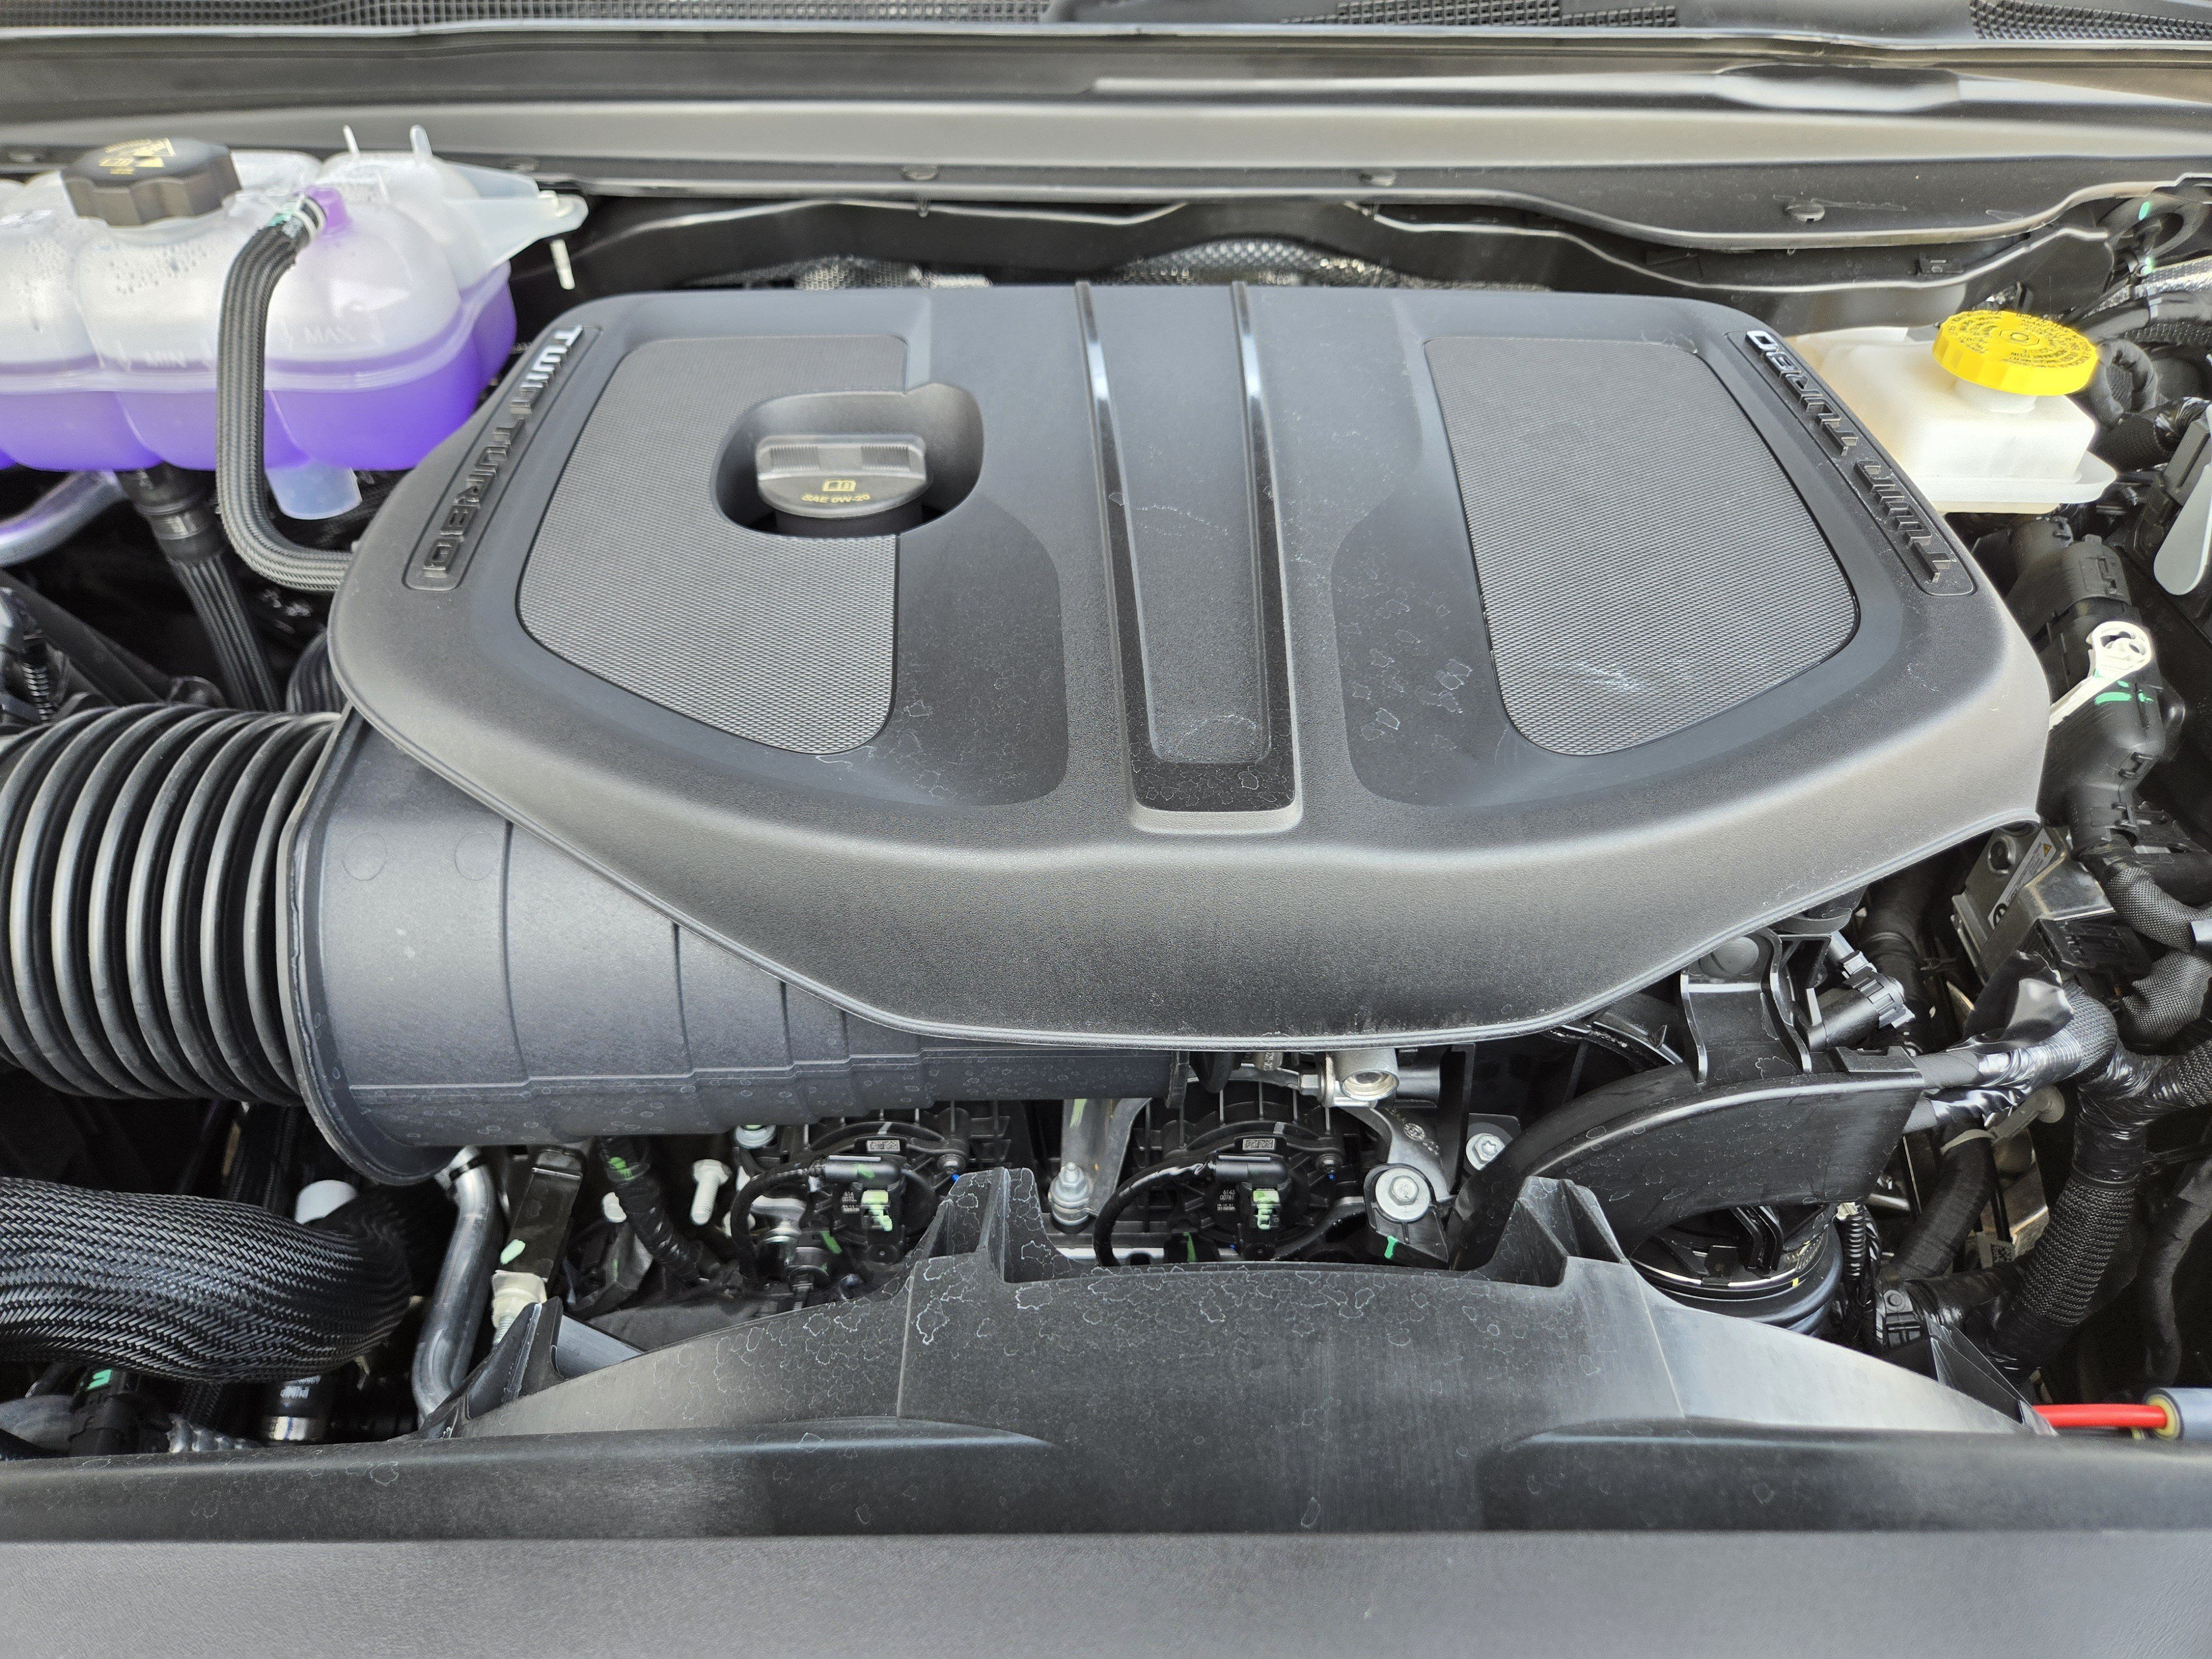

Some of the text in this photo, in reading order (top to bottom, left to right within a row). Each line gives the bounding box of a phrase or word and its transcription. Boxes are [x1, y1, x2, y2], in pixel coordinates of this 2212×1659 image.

[302, 326, 356, 344] MAX
[422, 324, 583, 578] TWIN TURBO
[801, 492, 829, 503] SAE
[1745, 330, 1953, 583] TWIN TURBO
